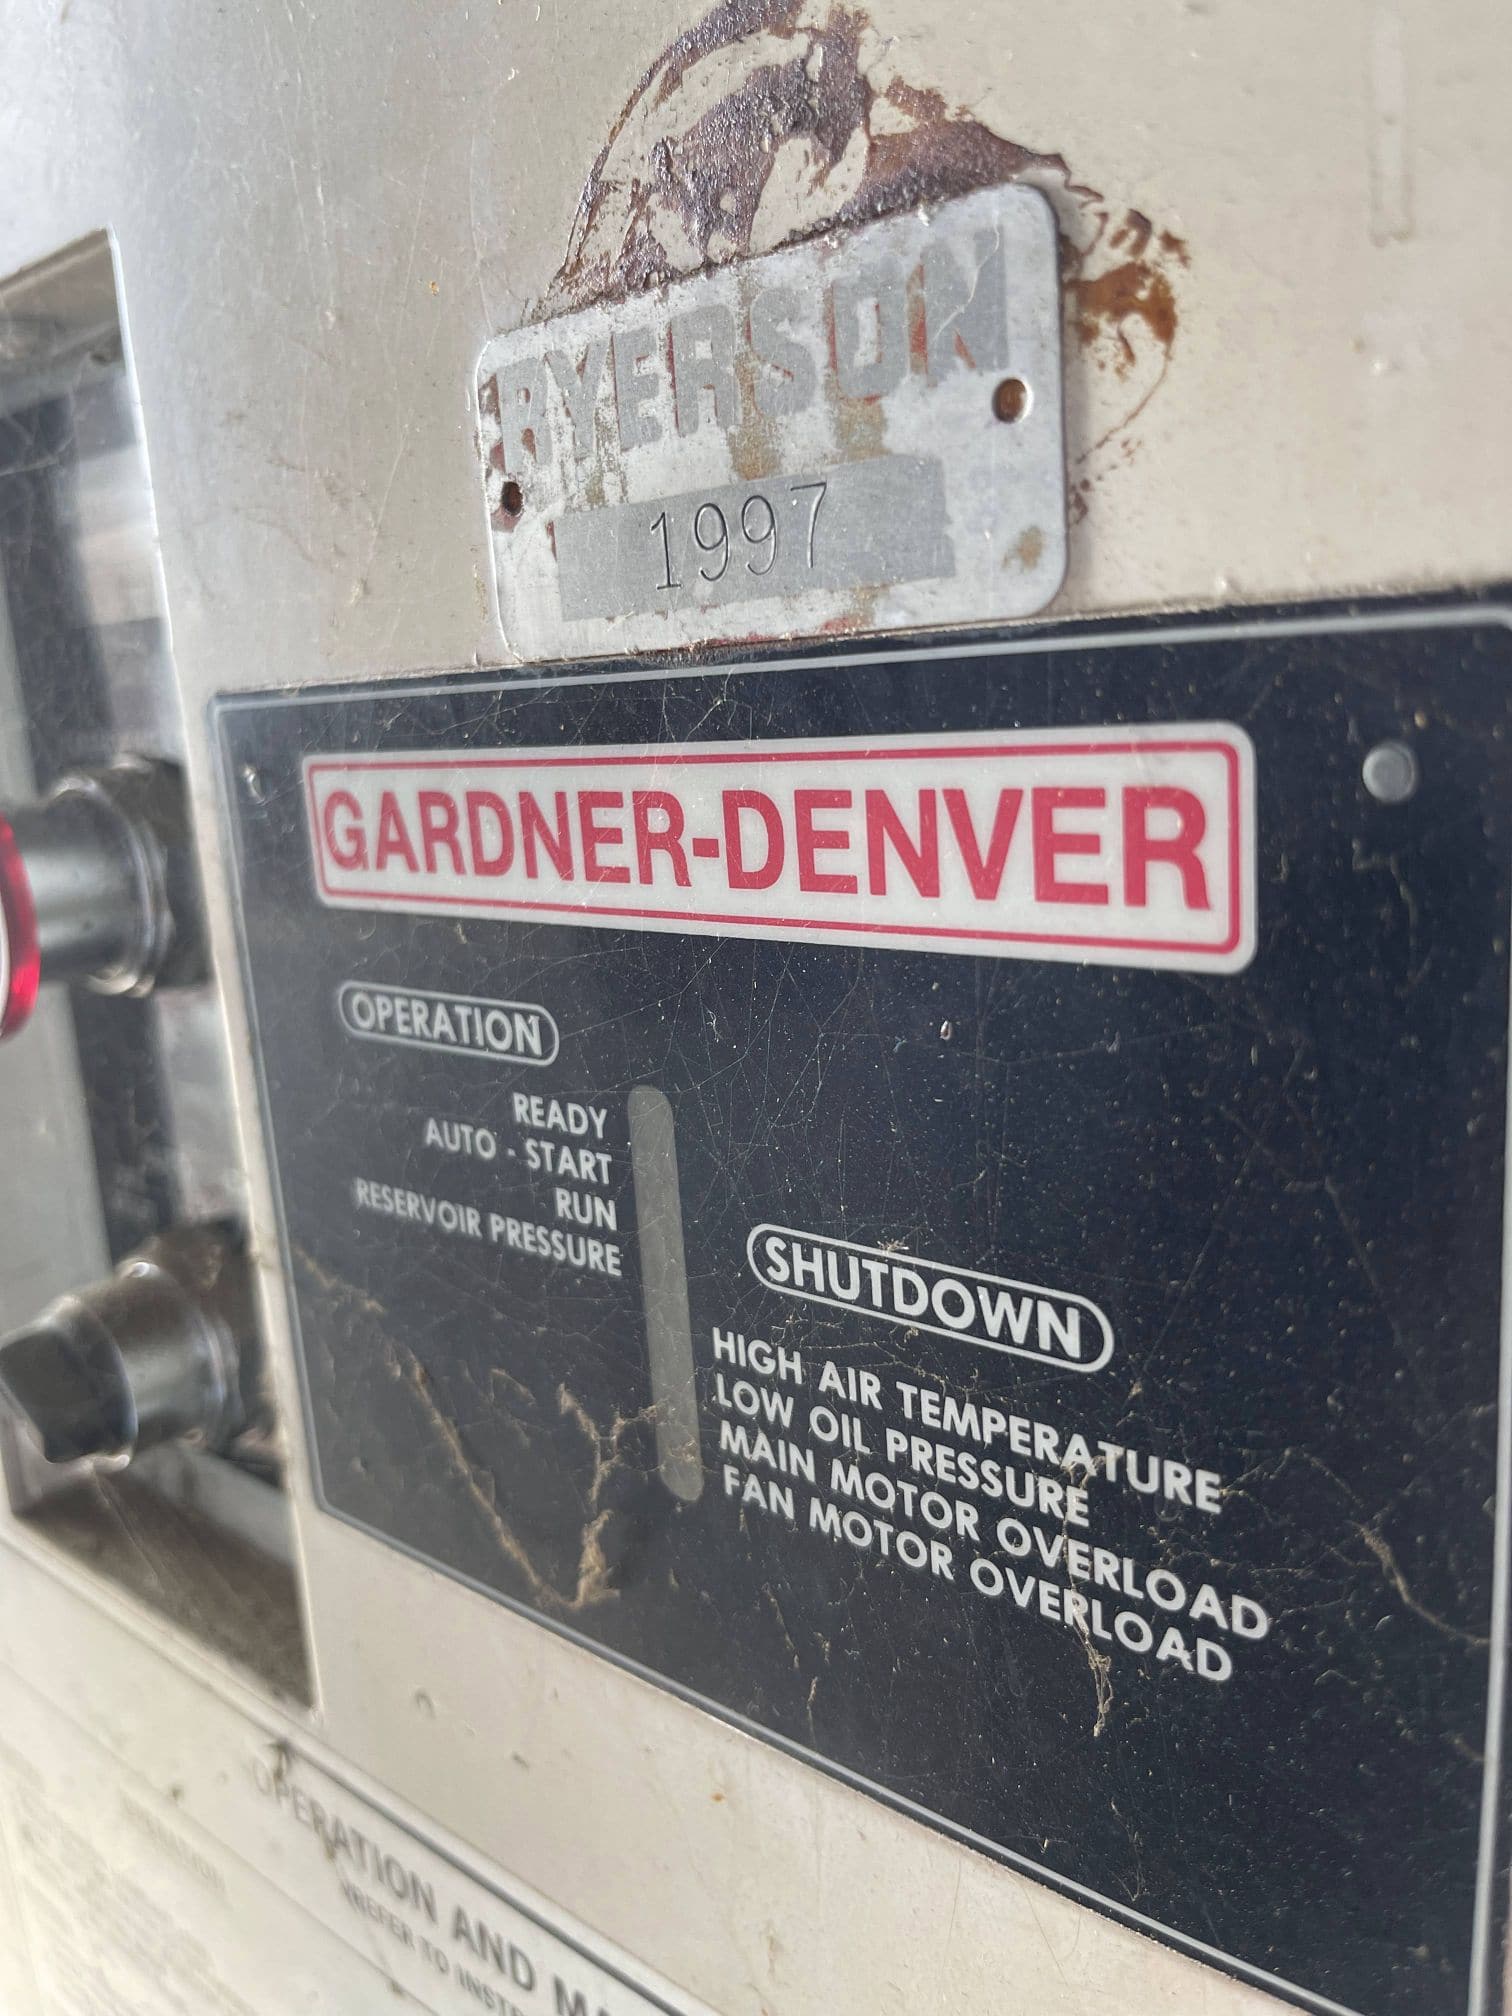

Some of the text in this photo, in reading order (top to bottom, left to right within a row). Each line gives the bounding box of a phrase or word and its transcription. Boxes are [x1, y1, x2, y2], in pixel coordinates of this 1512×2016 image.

[651, 481, 828, 591] 1997
[325, 786, 1212, 911] GARDNER-DENVER
[351, 992, 543, 1056] OPERATION
[425, 1118, 497, 1160] AUTO
[526, 1138, 612, 1185] START
[513, 1092, 608, 1139] READY
[356, 1176, 623, 1277] RESERVOIR PRESSURE
[556, 1186, 617, 1231] RUN
[765, 1237, 1082, 1359] SHUTDOWN
[712, 1326, 1222, 1514] HIGH AIR TEMPERATURE
[713, 1372, 1090, 1528] LOW OIL PRESSURE
[720, 1420, 1270, 1641] MAIN MOTOR OVERLOAD
[724, 1463, 1233, 1682] FAN MOTOR OVERLOAD
[451, 1904, 536, 1992] AND
[553, 1973, 612, 2016] M
